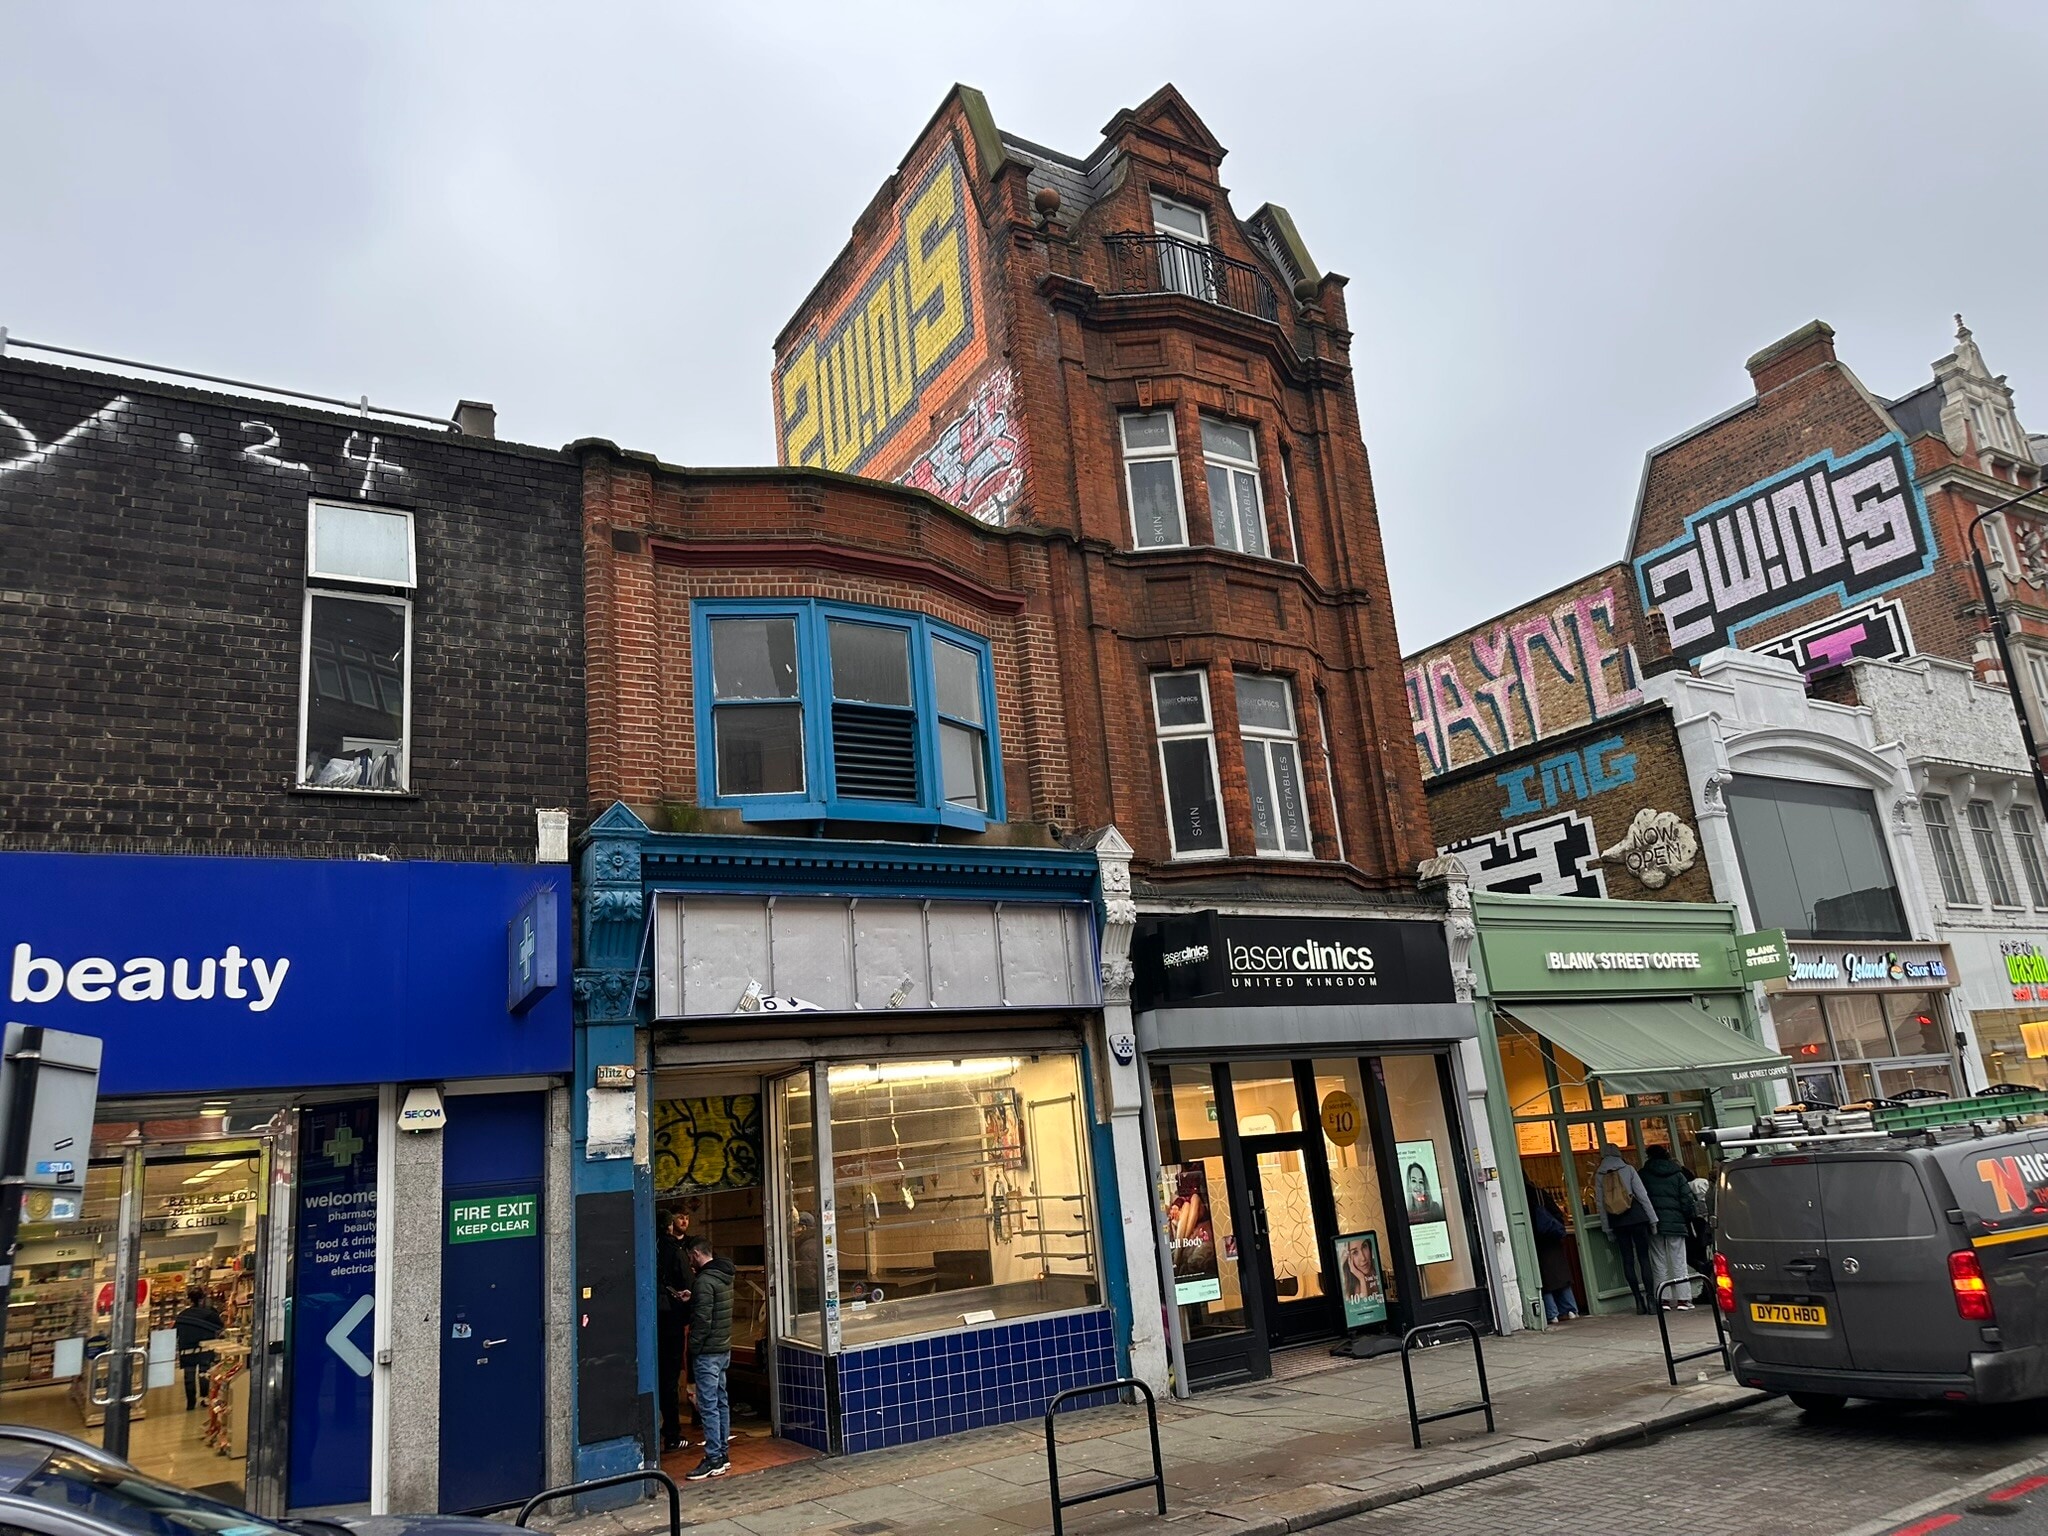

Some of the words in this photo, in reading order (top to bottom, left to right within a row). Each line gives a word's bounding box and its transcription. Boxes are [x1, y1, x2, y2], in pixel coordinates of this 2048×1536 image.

[1153, 516, 1165, 543] SKIN
[1496, 735, 1638, 820] IMG
[1279, 756, 1299, 837] INJECTABLES
[1190, 807, 1203, 836] SKIN
[1256, 796, 1268, 836] LASER
[1632, 821, 1676, 846] NOW
[1626, 843, 1683, 871] OPEN
[1163, 945, 1209, 965] laserclinics
[1227, 938, 1374, 971] laserclinics
[1745, 944, 1777, 957] BLANK
[1547, 952, 1599, 969] BLANK
[1599, 952, 1651, 969] STREET
[1652, 952, 1702, 969] COFFEE
[1746, 953, 1780, 967] STREET
[1788, 952, 1839, 982] Camden
[1929, 961, 1947, 977] Hub
[10, 943, 290, 1012] beauty
[1232, 977, 1294, 988] UNITED
[1306, 976, 1378, 987] KINGDOM
[598, 1067, 623, 1079] blitz
[1731, 1071, 1750, 1081] BLANK
[1749, 1068, 1768, 1079] STREET
[1768, 1066, 1788, 1076] COFFEE
[404, 1108, 441, 1119] SECOM
[1329, 1111, 1353, 1133] £10
[49, 1162, 72, 1173] STILO
[305, 1191, 377, 1209] welcome
[327, 1209, 377, 1222] pharmacy
[454, 1205, 491, 1221] FIRE
[497, 1202, 532, 1217] EXIT
[141, 1220, 167, 1232] ABY
[171, 1219, 179, 1230] &
[186, 1216, 228, 1228] CHILD
[344, 1221, 377, 1233] beauty
[456, 1224, 488, 1236] KEEP
[490, 1219, 530, 1232] CLEAR
[315, 1239, 339, 1250] food
[341, 1237, 349, 1247] &
[351, 1234, 377, 1246] drink
[1169, 1239, 1181, 1249] ull
[1182, 1236, 1204, 1249] Body
[315, 1252, 341, 1264] baby
[343, 1250, 351, 1261] &
[330, 1261, 377, 1277] electrical
[1757, 1305, 1791, 1321] DY70
[1793, 1308, 1820, 1323] HBO
